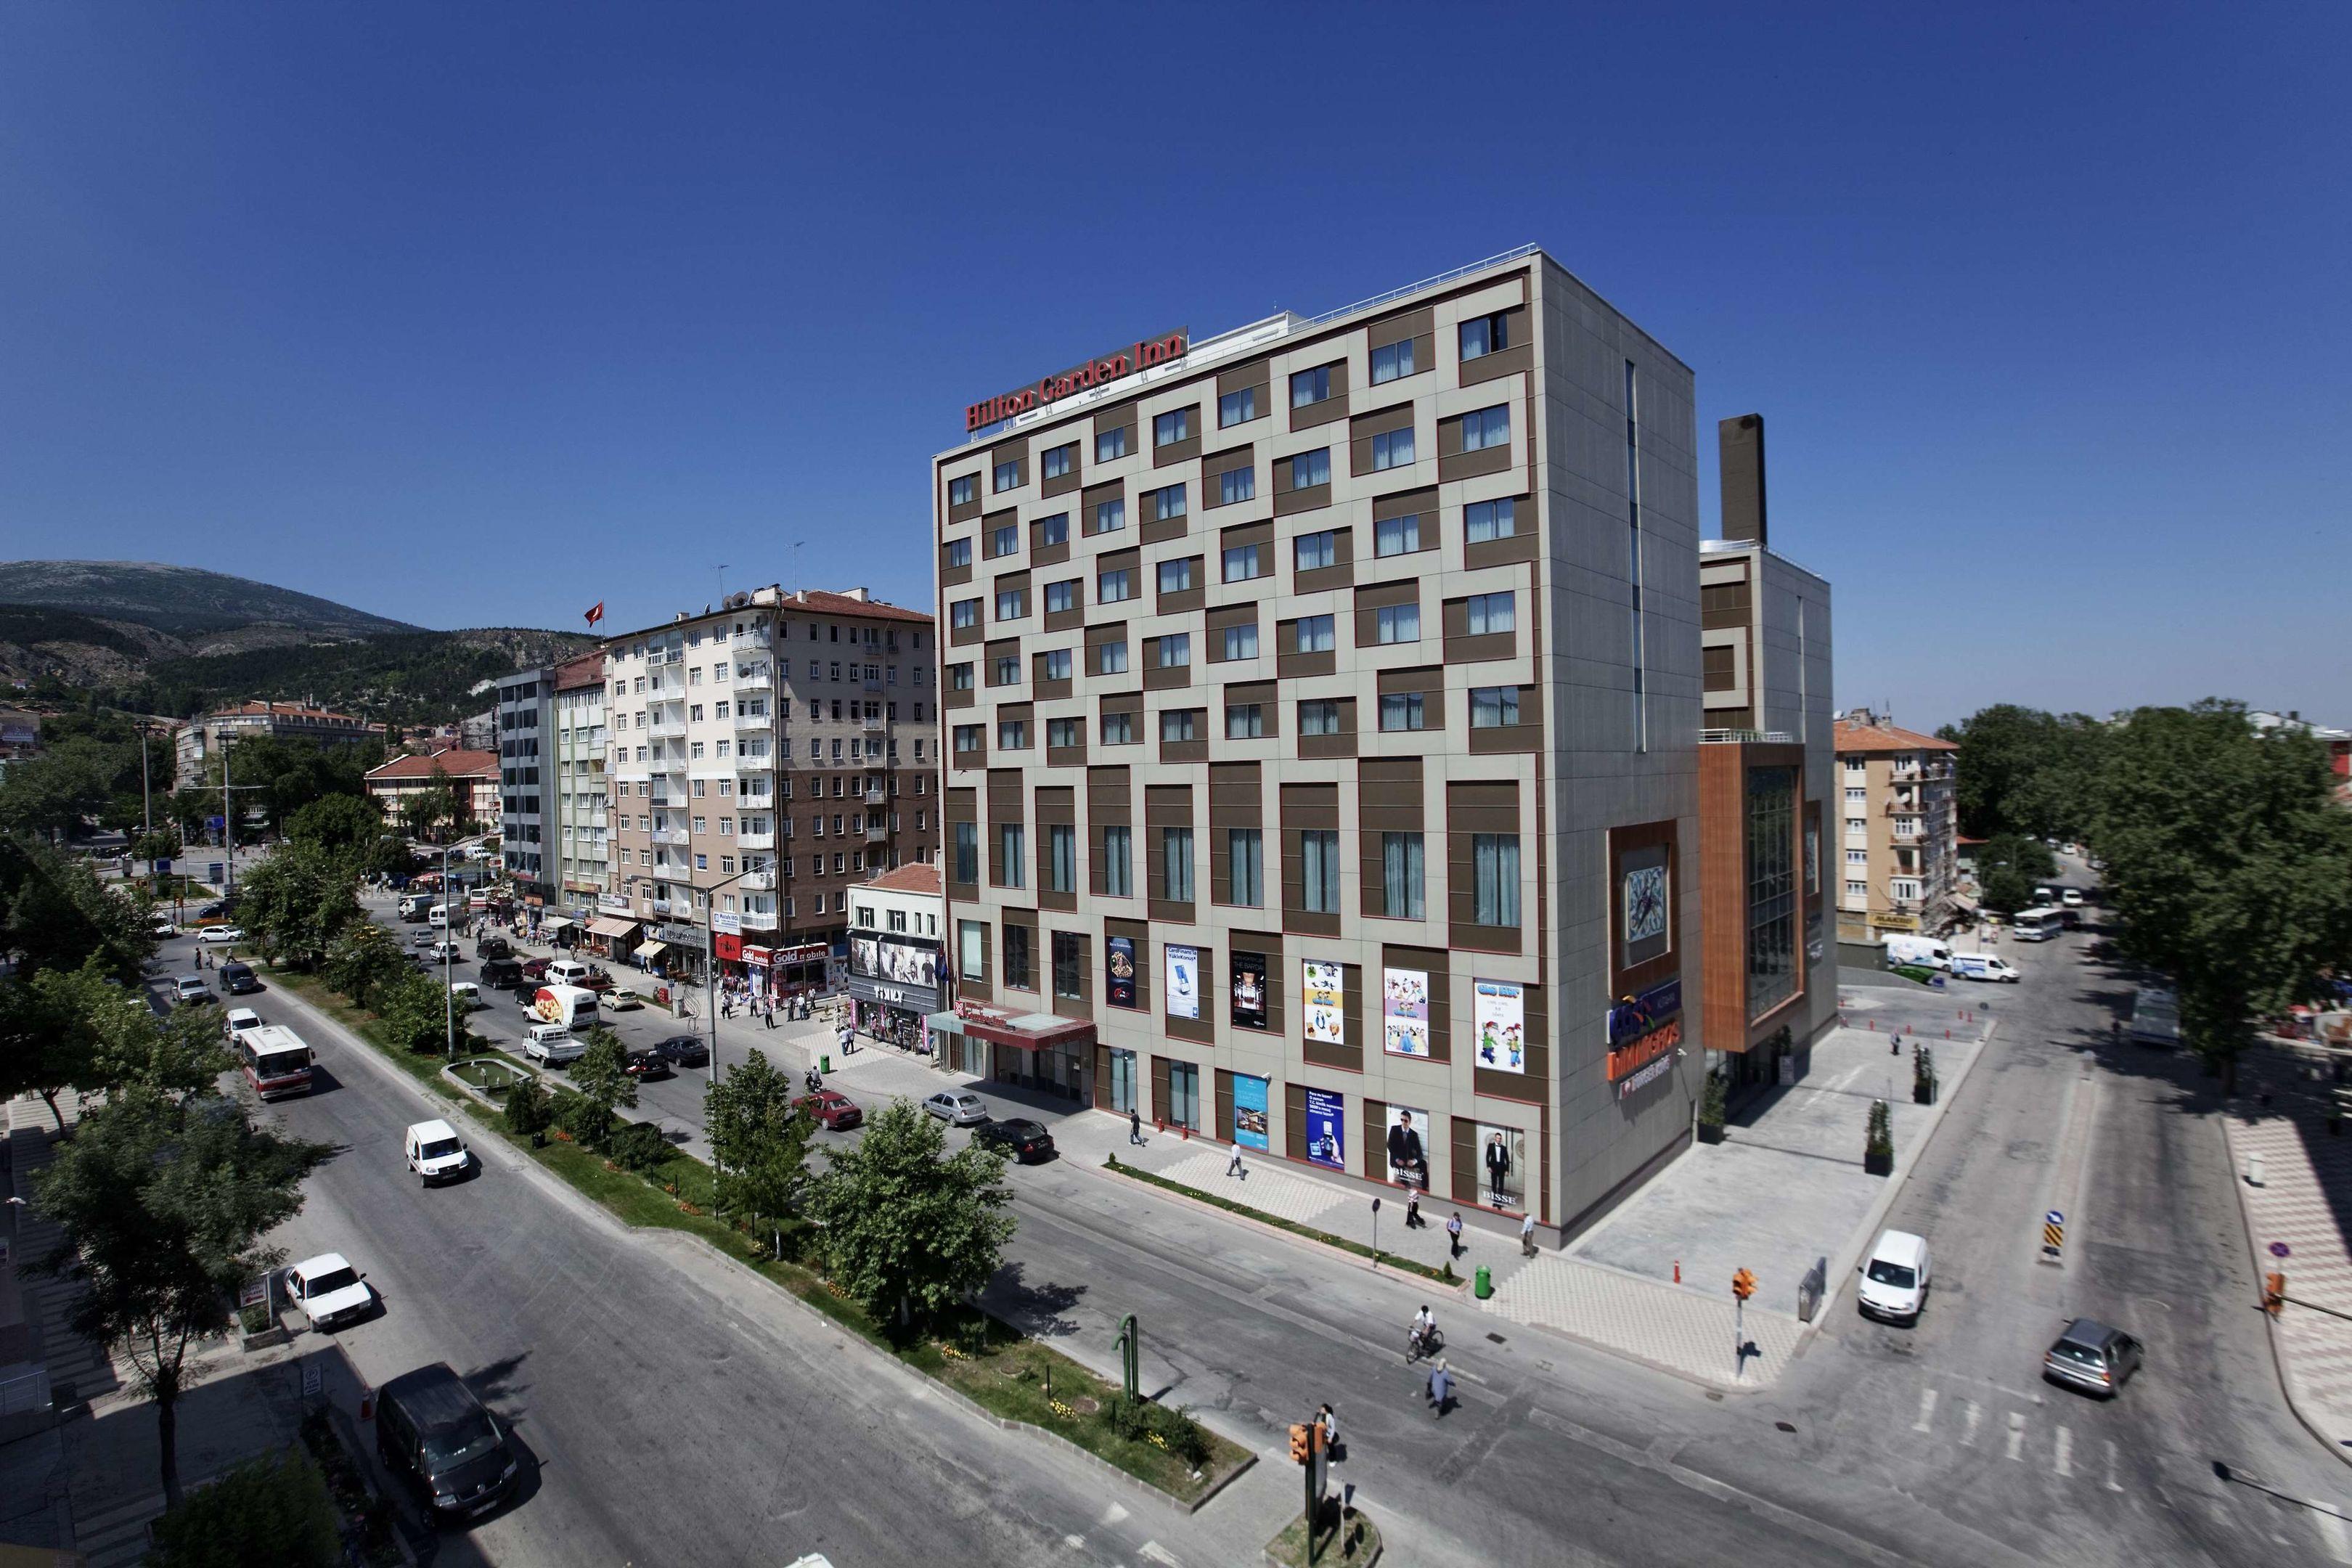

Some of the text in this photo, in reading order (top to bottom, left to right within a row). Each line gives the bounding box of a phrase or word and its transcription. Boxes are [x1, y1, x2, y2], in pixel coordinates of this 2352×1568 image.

[965, 333, 1183, 431] Hilton Garden Inn
[742, 950, 754, 960] Gold
[773, 950, 798, 963] Gold
